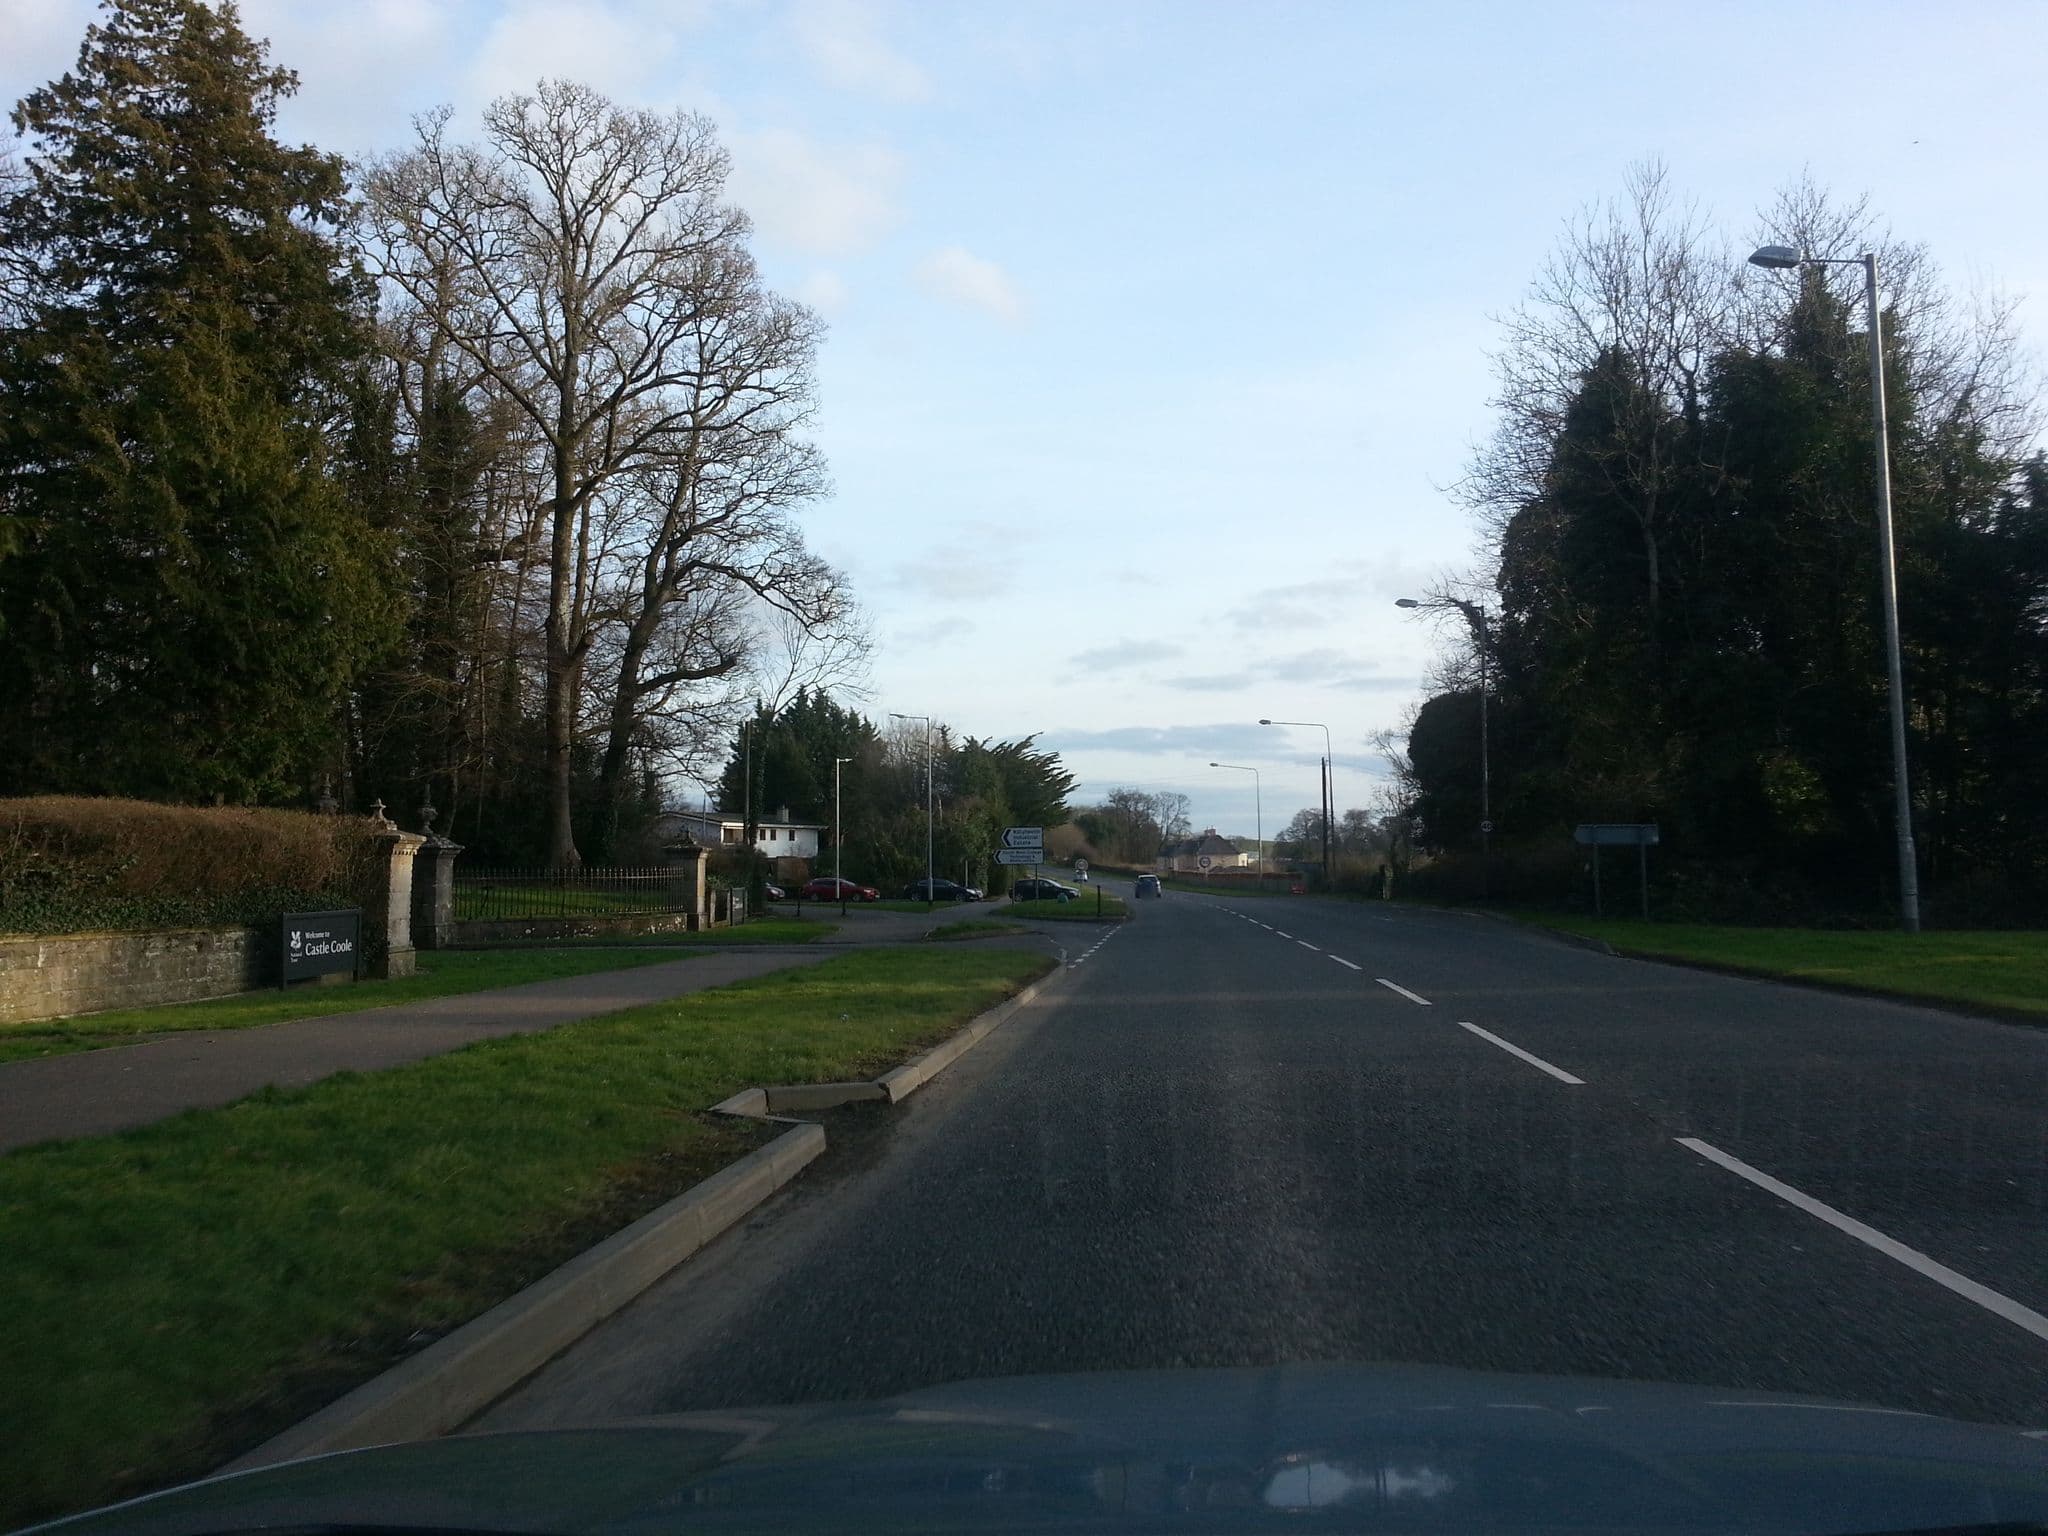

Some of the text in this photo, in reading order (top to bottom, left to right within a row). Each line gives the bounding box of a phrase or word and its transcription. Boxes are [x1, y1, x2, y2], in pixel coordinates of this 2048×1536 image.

[305, 931, 324, 939] Welcome
[305, 938, 352, 956] Castle Coole
